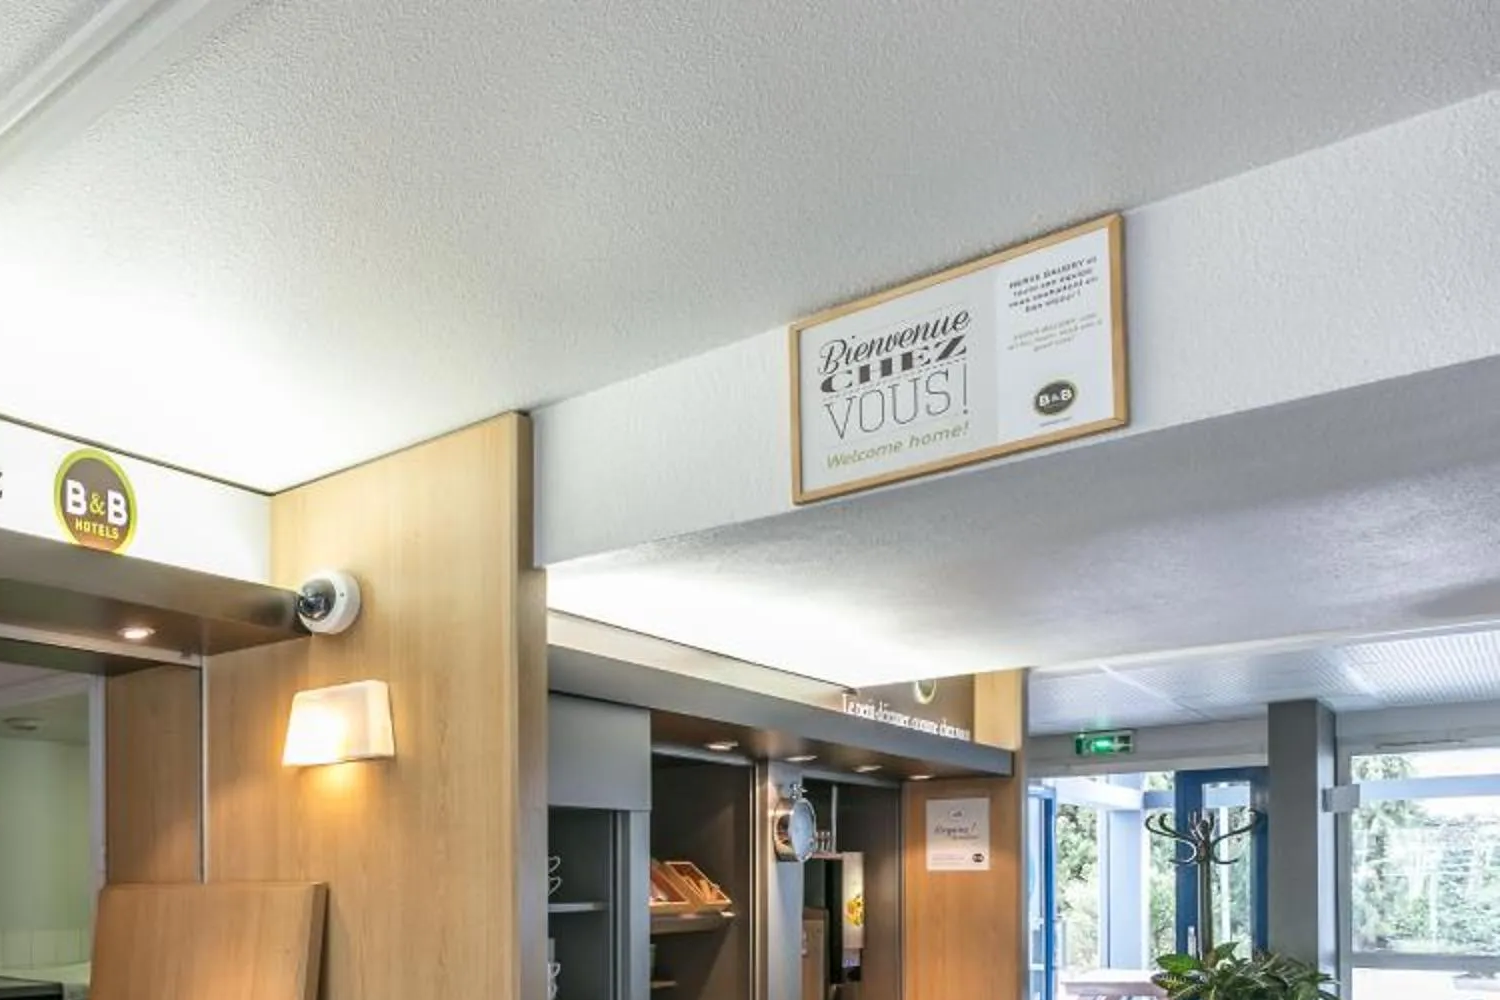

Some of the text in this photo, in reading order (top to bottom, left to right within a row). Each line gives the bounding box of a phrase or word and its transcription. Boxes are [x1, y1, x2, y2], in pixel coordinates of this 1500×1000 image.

[819, 308, 971, 375] Bienvenue
[820, 335, 968, 394] CHEZ
[826, 421, 969, 469] Welcome home!
[64, 478, 128, 527] B&B
[74, 518, 120, 541] HOTELS
